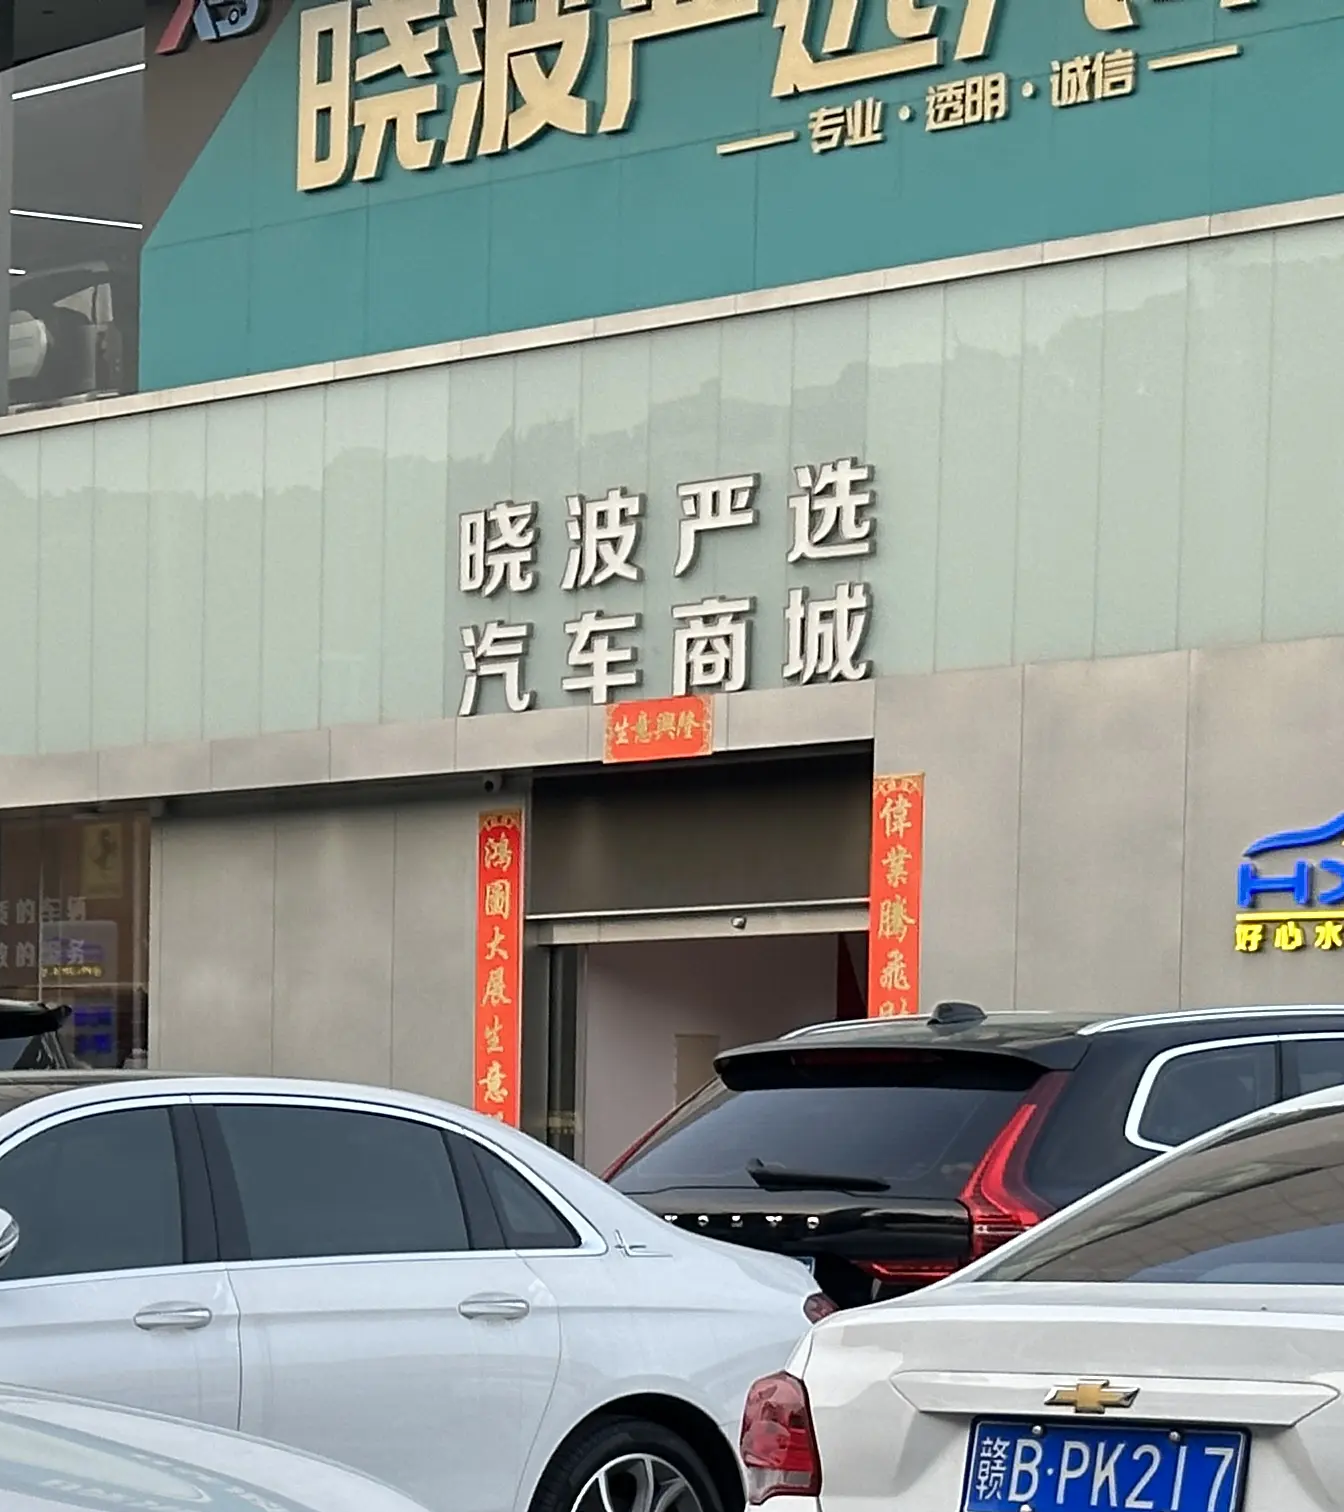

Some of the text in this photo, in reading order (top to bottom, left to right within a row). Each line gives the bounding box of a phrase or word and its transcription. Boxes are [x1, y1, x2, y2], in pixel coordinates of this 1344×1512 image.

[459, 456, 873, 597] 晓波严选
[458, 581, 872, 716] 汽车商城
[1235, 921, 1344, 951] 好心水
